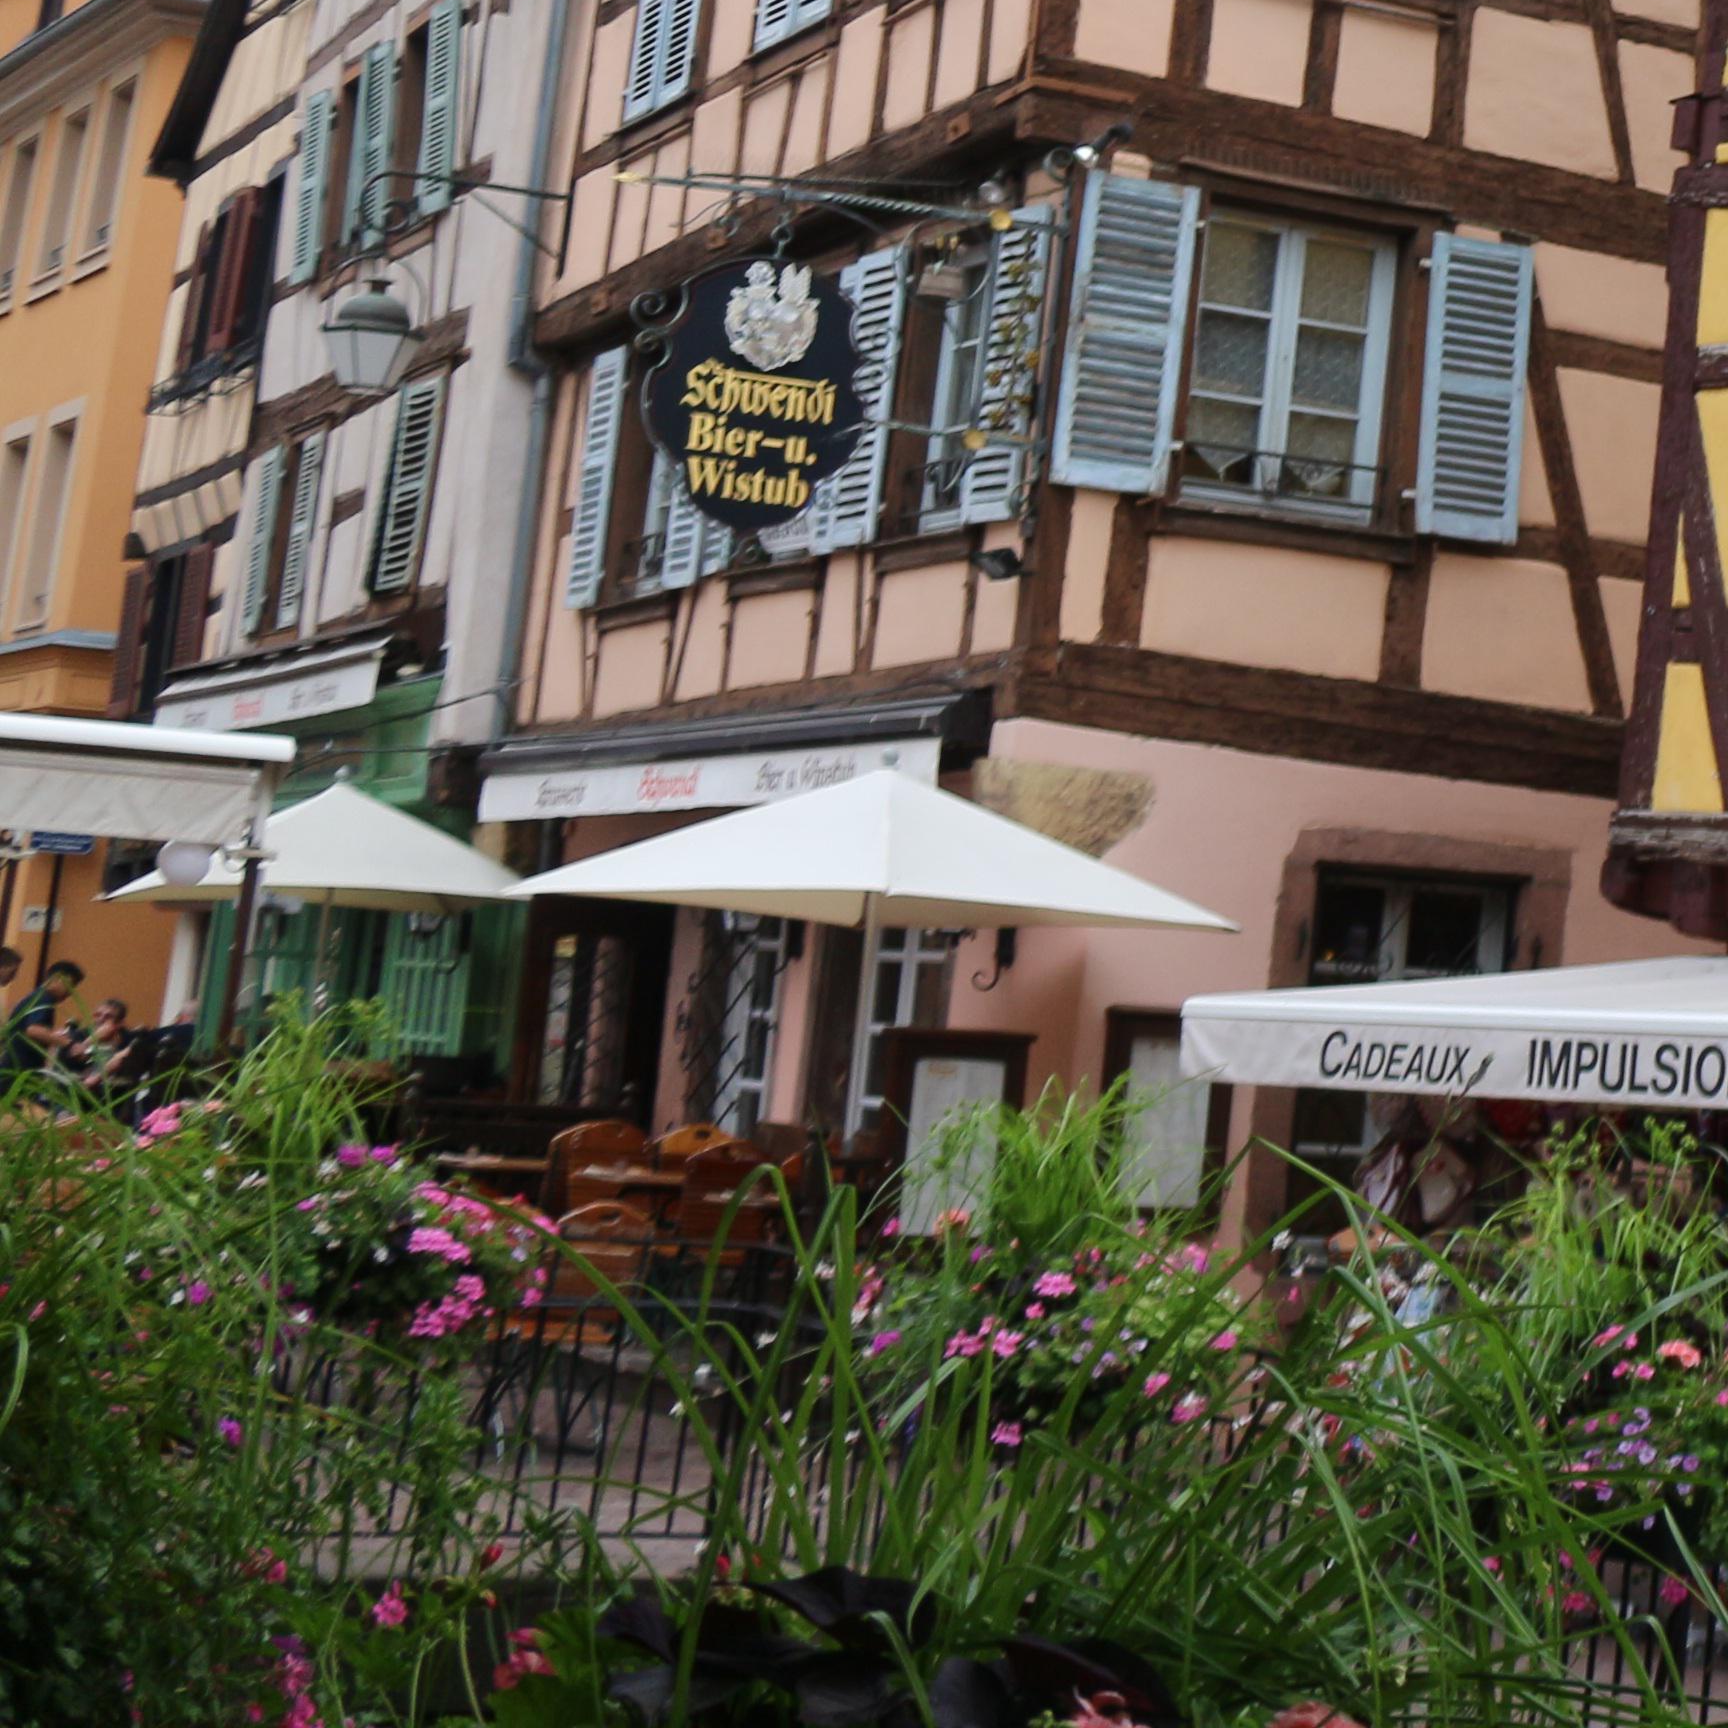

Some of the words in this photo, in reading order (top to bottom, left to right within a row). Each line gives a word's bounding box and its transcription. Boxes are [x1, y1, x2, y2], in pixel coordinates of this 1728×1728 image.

[679, 357, 839, 426] Schwendi
[687, 455, 810, 509] Wistub
[1318, 1029, 1471, 1086] CADEAUX
